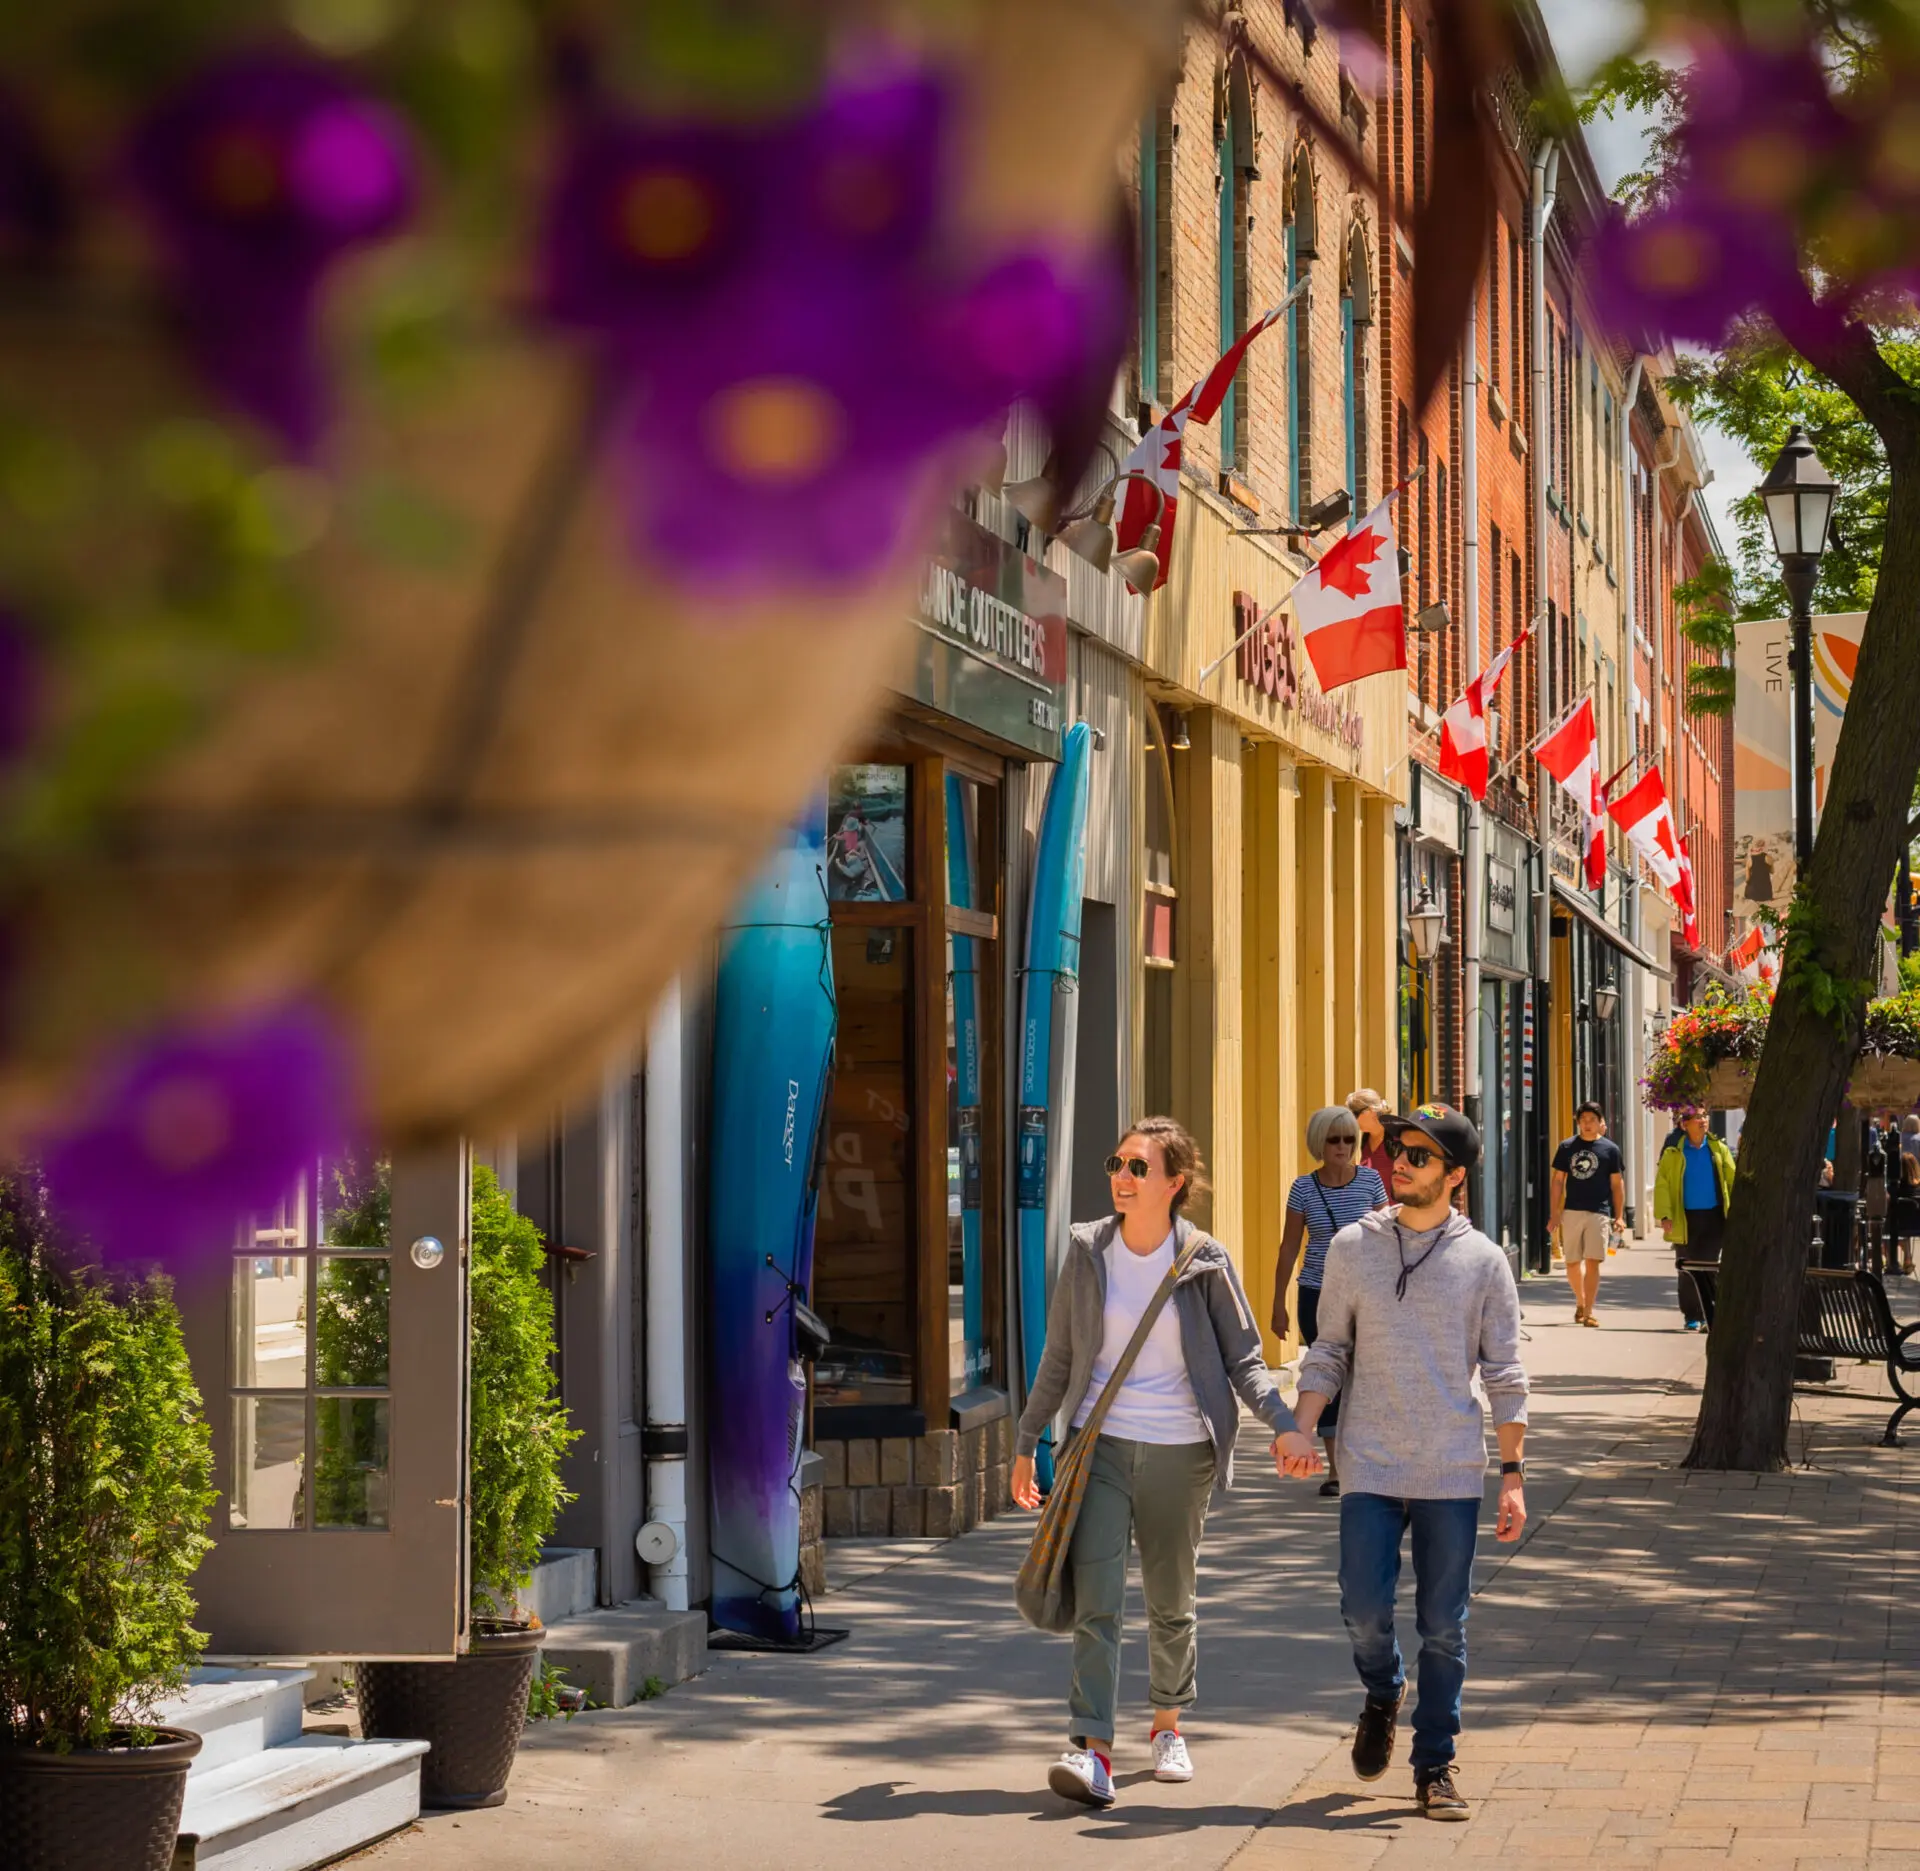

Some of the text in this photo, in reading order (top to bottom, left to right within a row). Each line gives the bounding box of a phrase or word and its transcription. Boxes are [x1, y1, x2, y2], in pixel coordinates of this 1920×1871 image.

[971, 586, 1046, 676] OUTFITTERS
[1766, 642, 1782, 693] LIVE
[783, 1079, 799, 1172] Dagger
